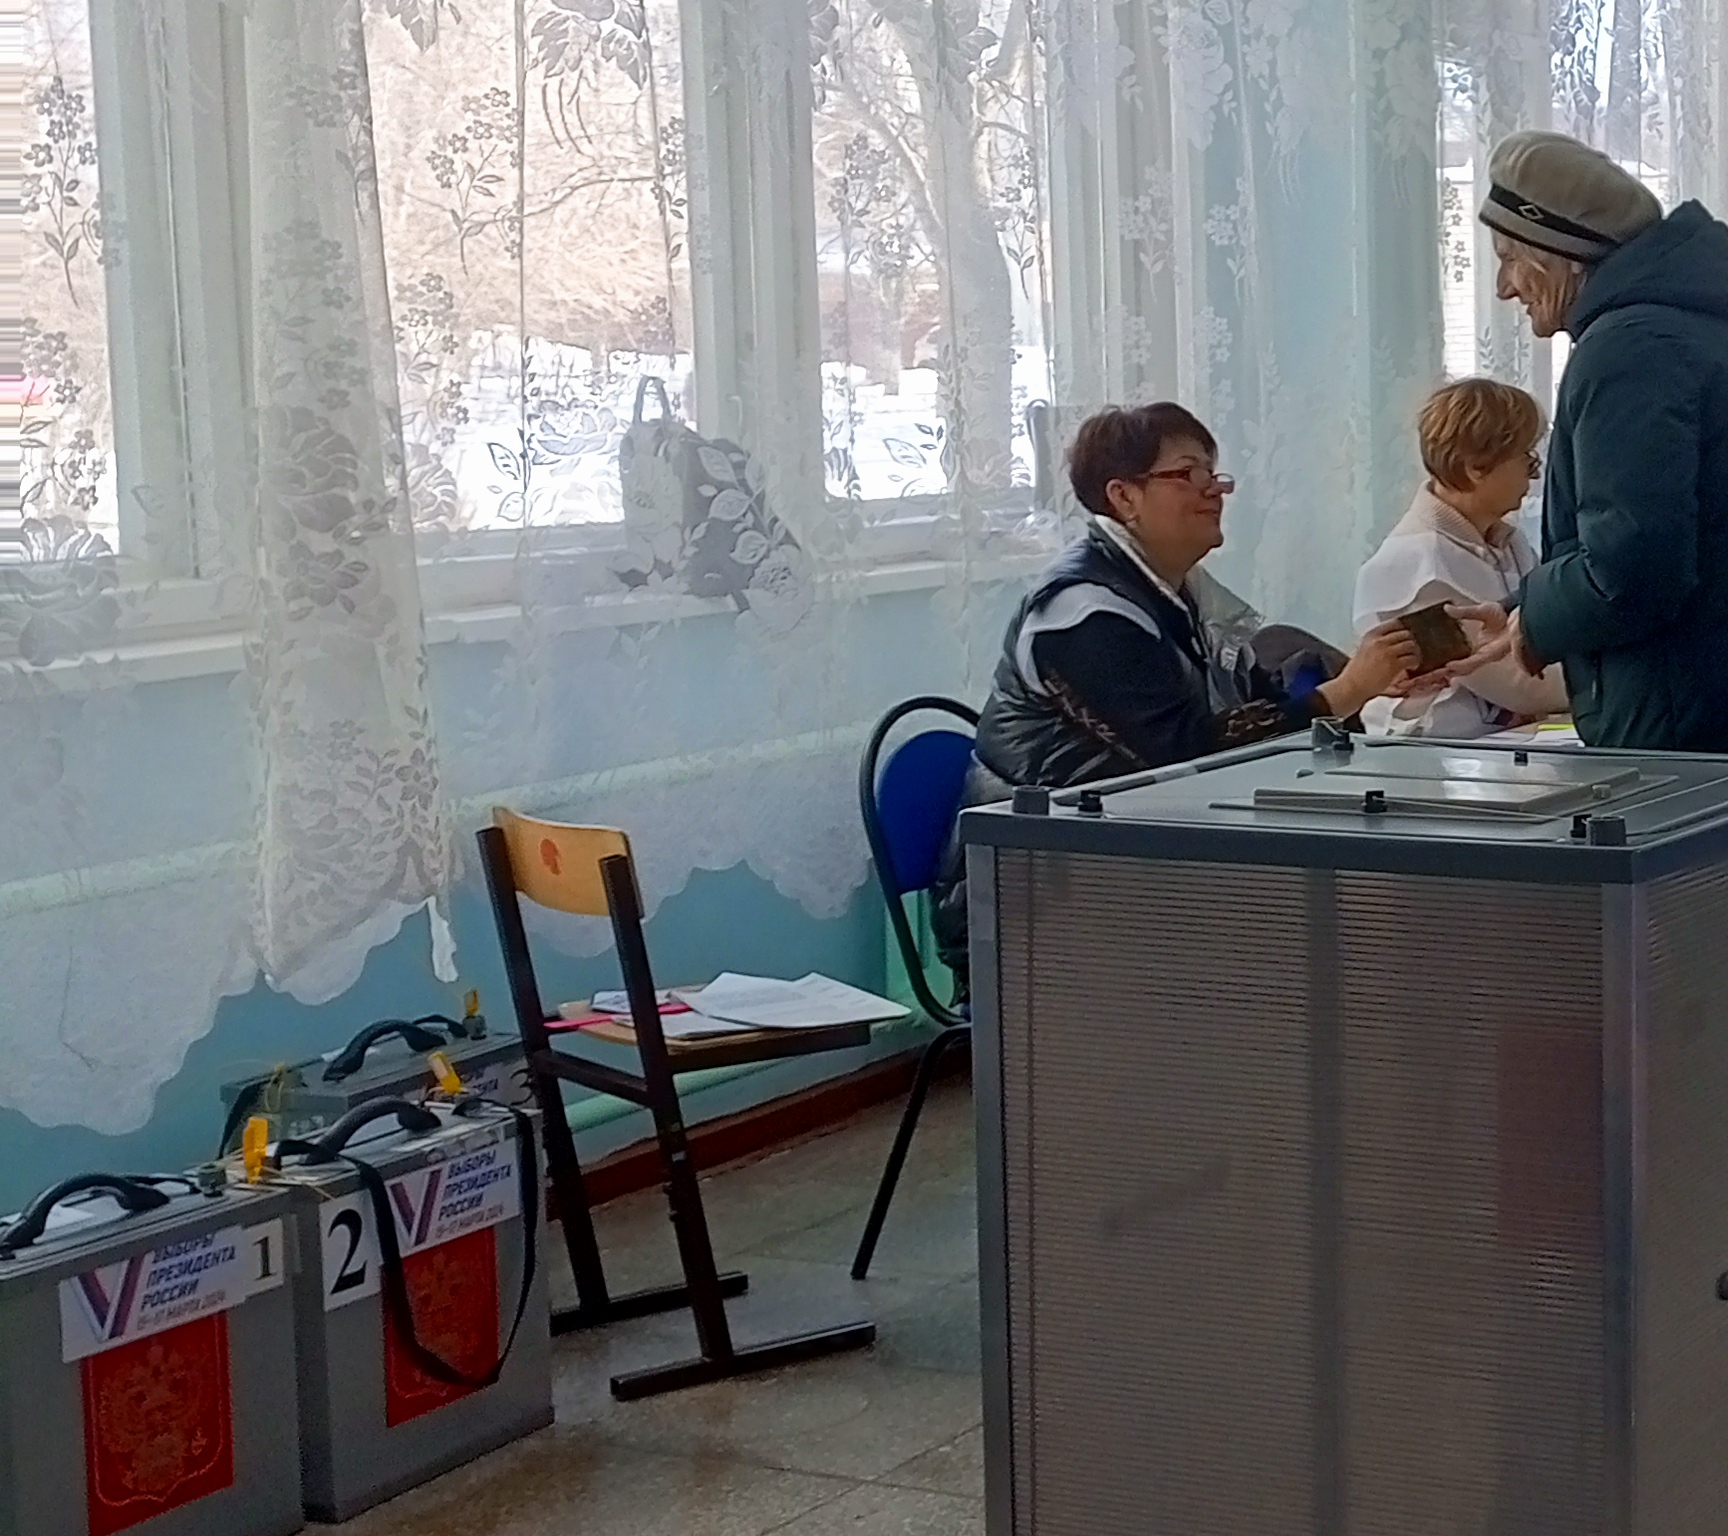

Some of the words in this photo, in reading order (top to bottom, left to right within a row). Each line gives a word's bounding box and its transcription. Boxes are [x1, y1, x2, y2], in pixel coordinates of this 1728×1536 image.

[448, 1150, 496, 1179] ВЫБОРЫ
[442, 1165, 511, 1201] ПРЕЗИДЕНТА
[439, 1193, 483, 1221] РОССИИ
[146, 1246, 236, 1288] ПРЕЗИДЕНТА
[254, 1236, 274, 1280] 1
[328, 1208, 367, 1294] 2
[141, 1279, 199, 1311] РОССИИ
